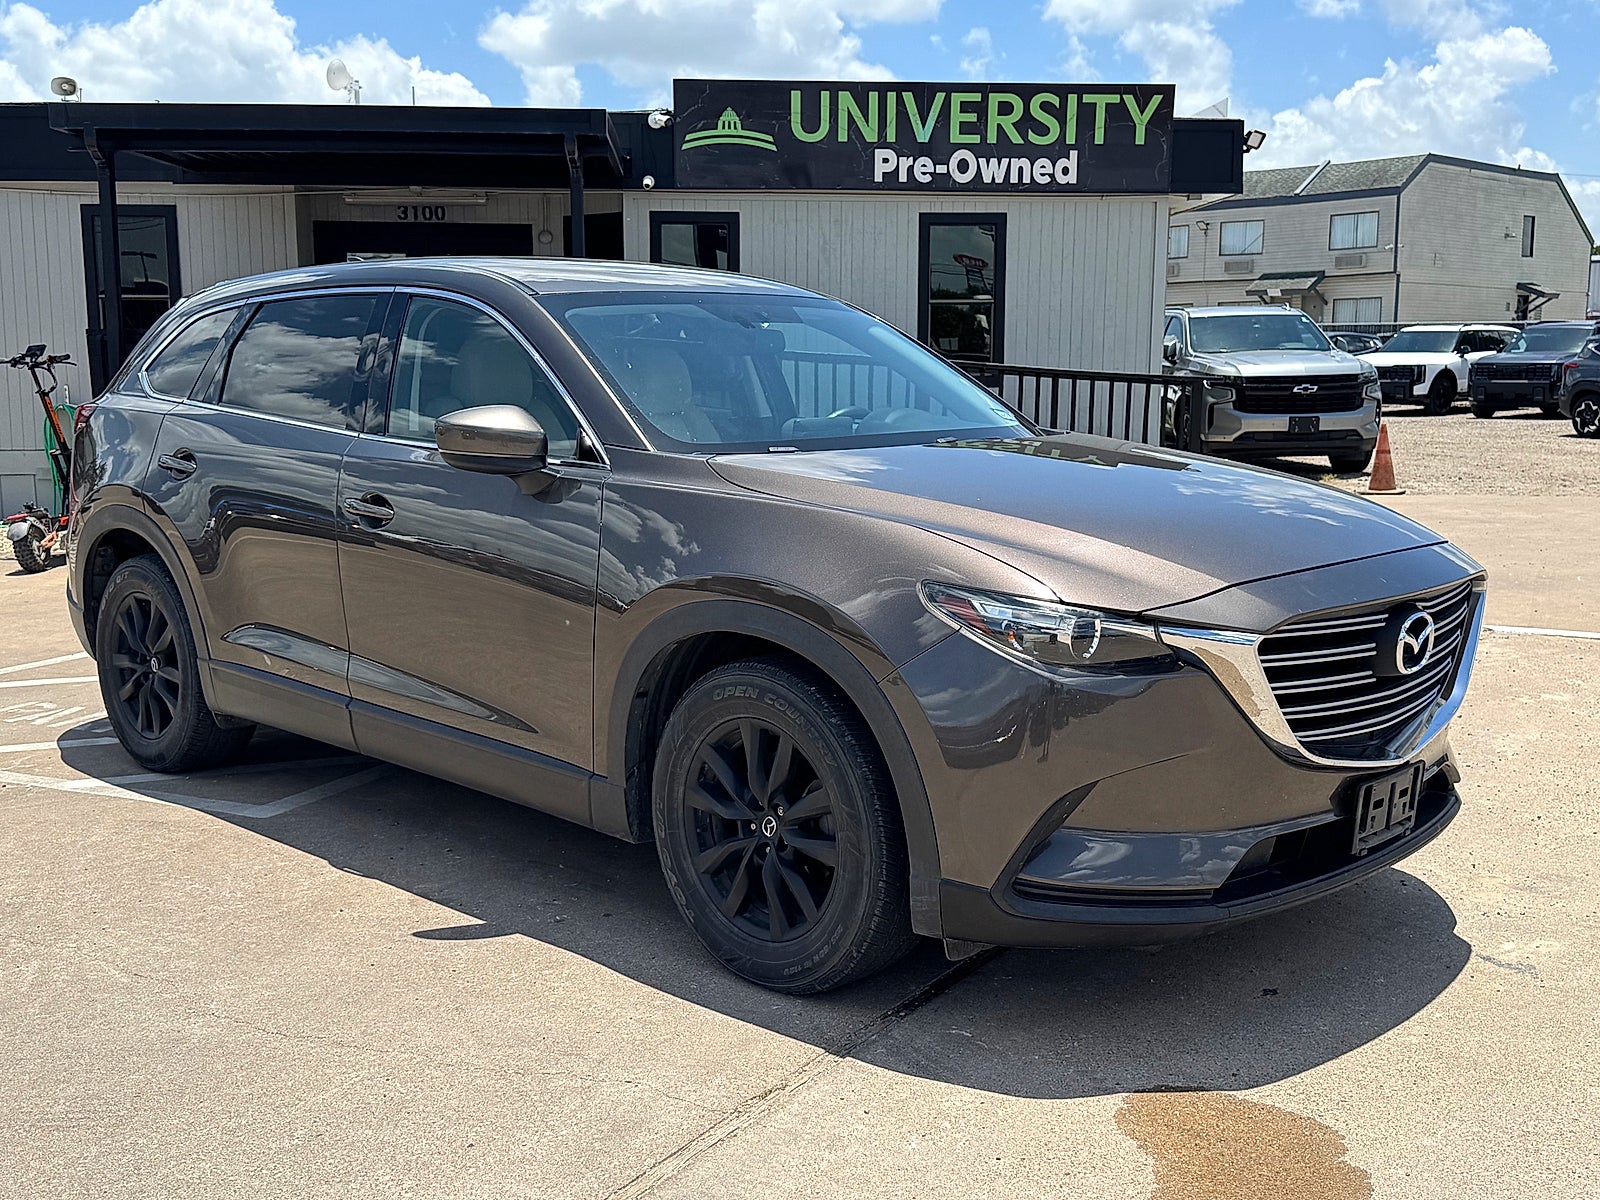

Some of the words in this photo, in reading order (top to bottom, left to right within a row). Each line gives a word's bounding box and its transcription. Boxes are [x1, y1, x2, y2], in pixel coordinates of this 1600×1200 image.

[790, 89, 1163, 146] UNIVERSITY
[874, 149, 1077, 184] Pre-Owned
[397, 205, 446, 221] 3100
[712, 685, 759, 701] OPEN
